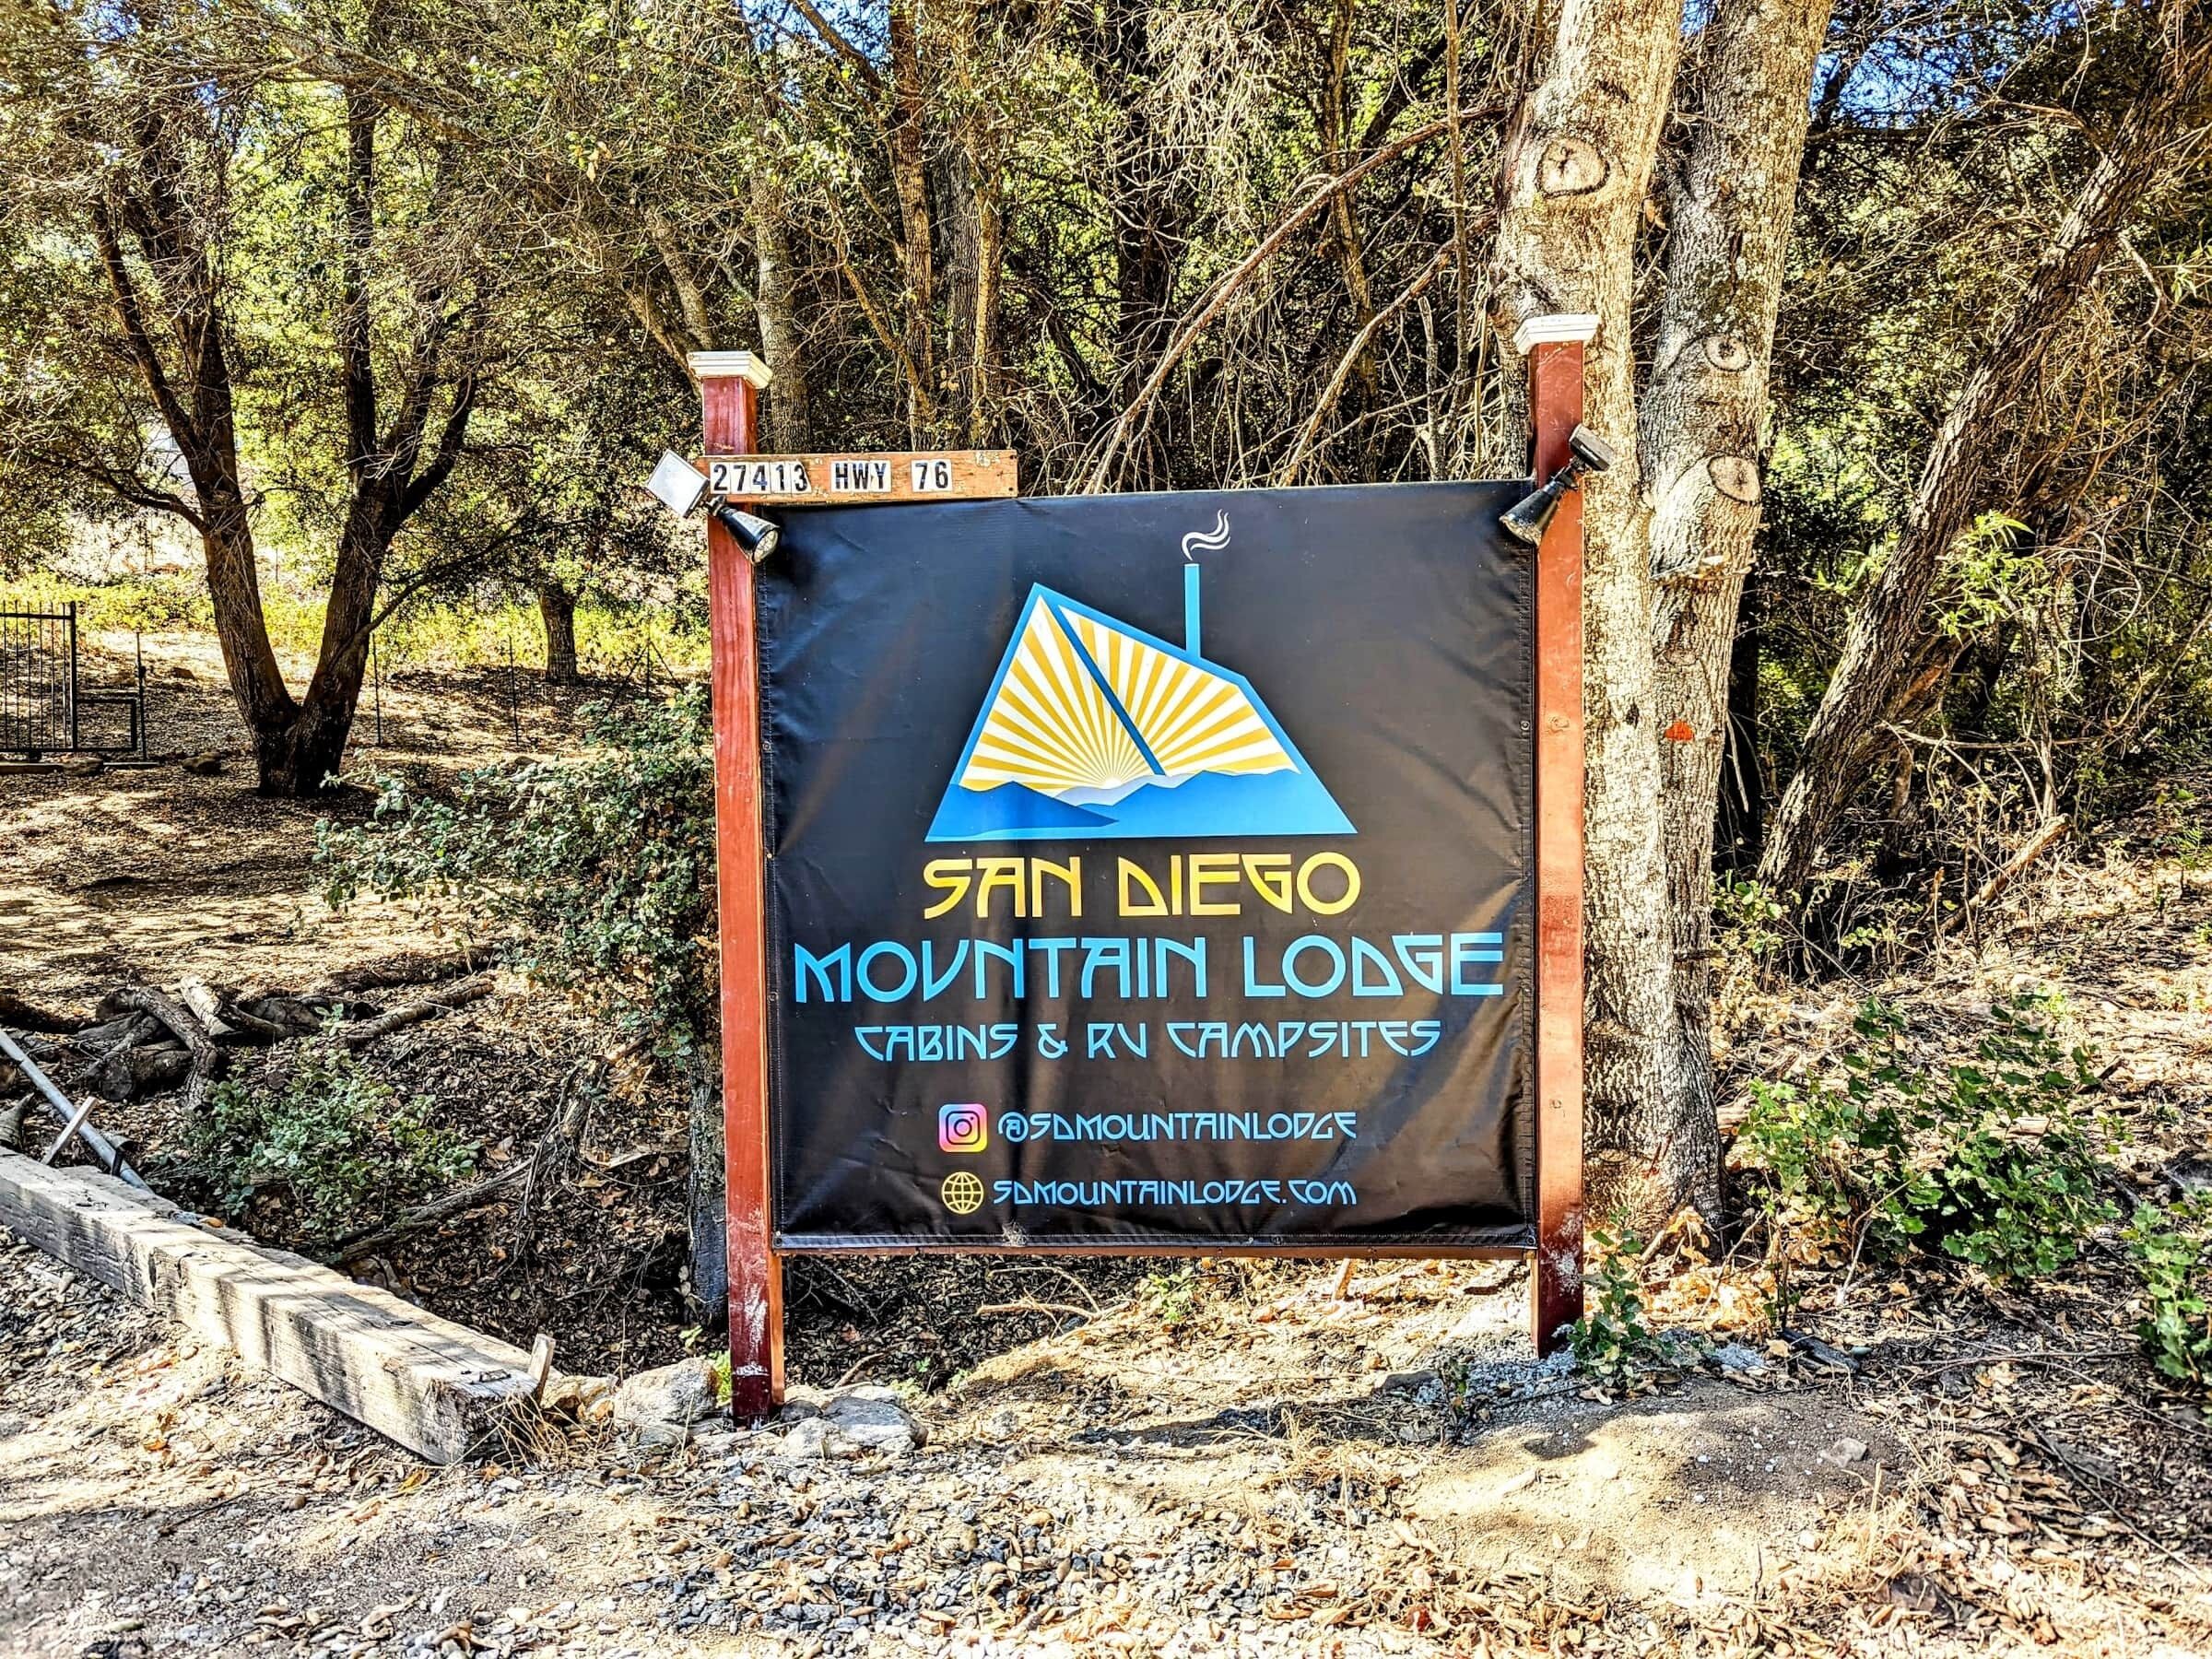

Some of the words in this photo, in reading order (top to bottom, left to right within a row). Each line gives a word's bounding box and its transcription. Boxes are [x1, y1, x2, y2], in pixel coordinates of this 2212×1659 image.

[712, 462, 808, 492] 27413
[834, 462, 887, 490] HWY
[914, 461, 949, 490] 76
[923, 855, 1084, 920] SAN
[1118, 852, 1362, 918] DIEGO
[794, 936, 1207, 1004] MOUNTAIN
[1244, 932, 1505, 998] LODGE
[853, 1023, 1018, 1062] CABINS
[1037, 1022, 1068, 1060] &
[1087, 1020, 1148, 1060] RV
[1168, 1019, 1441, 1059] CAMPSITES
[997, 1111, 1358, 1143] @SDMOUNTAINLODGE
[993, 1179, 1358, 1206] SDMOUNTAINLODGE.COM
